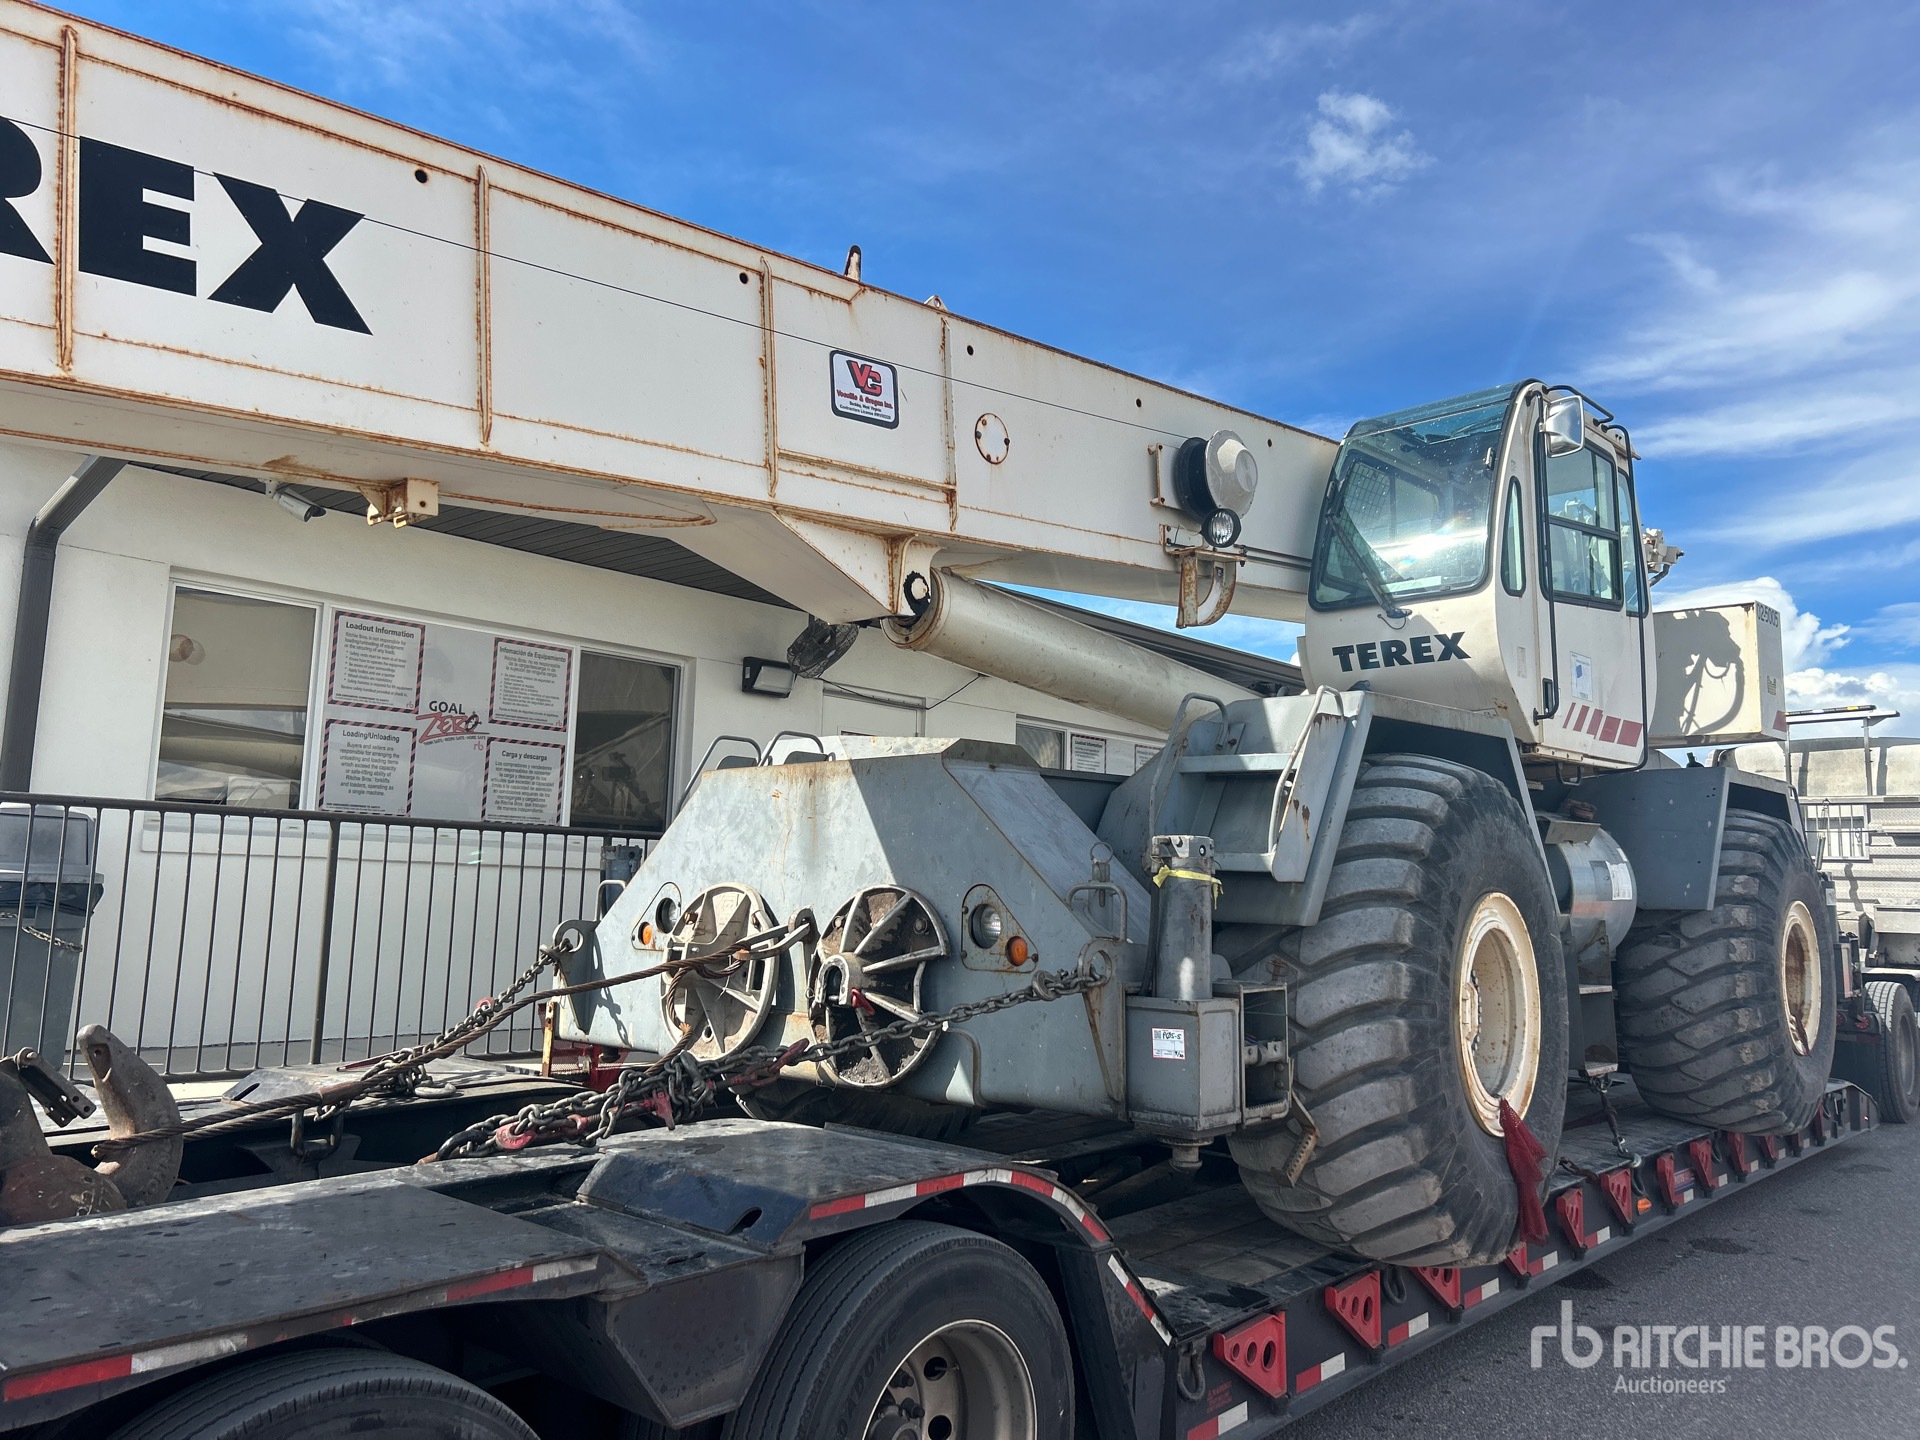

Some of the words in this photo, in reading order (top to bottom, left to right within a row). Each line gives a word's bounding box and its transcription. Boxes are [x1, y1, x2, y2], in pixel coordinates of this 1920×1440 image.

[884, 401, 893, 409] Inc.
[1757, 604, 1778, 628] 02-5005
[346, 621, 374, 631] Loadout
[375, 626, 414, 638] Information
[534, 652, 566, 663] Equipamiento
[1332, 632, 1472, 672] TEREX
[429, 701, 465, 714] GOAL
[416, 711, 482, 743] ZERO
[342, 730, 400, 743] Loading/Unloading
[473, 741, 483, 750] rb
[502, 750, 518, 759] Carga
[523, 752, 548, 762] descarga
